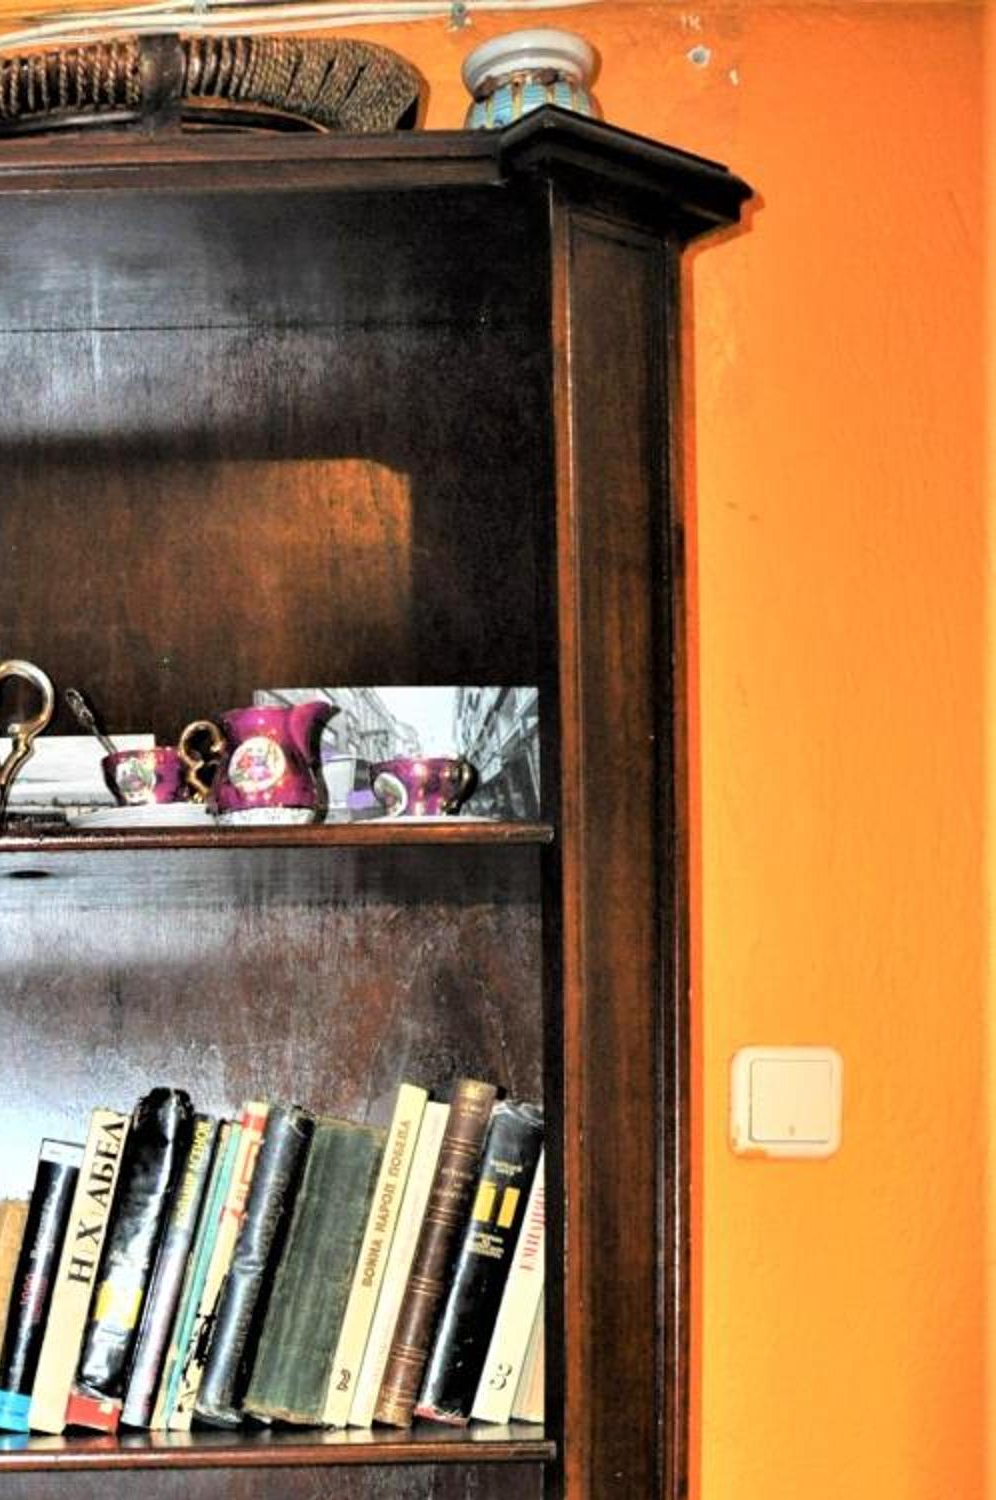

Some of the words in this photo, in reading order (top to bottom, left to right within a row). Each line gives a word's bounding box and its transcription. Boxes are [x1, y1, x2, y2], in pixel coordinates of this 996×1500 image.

[87, 1120, 125, 1209] АБЕЛ
[362, 1238, 383, 1288] ВОЙНА
[374, 1182, 396, 1233] НАРОД
[388, 1119, 411, 1178] ПОБЕДА
